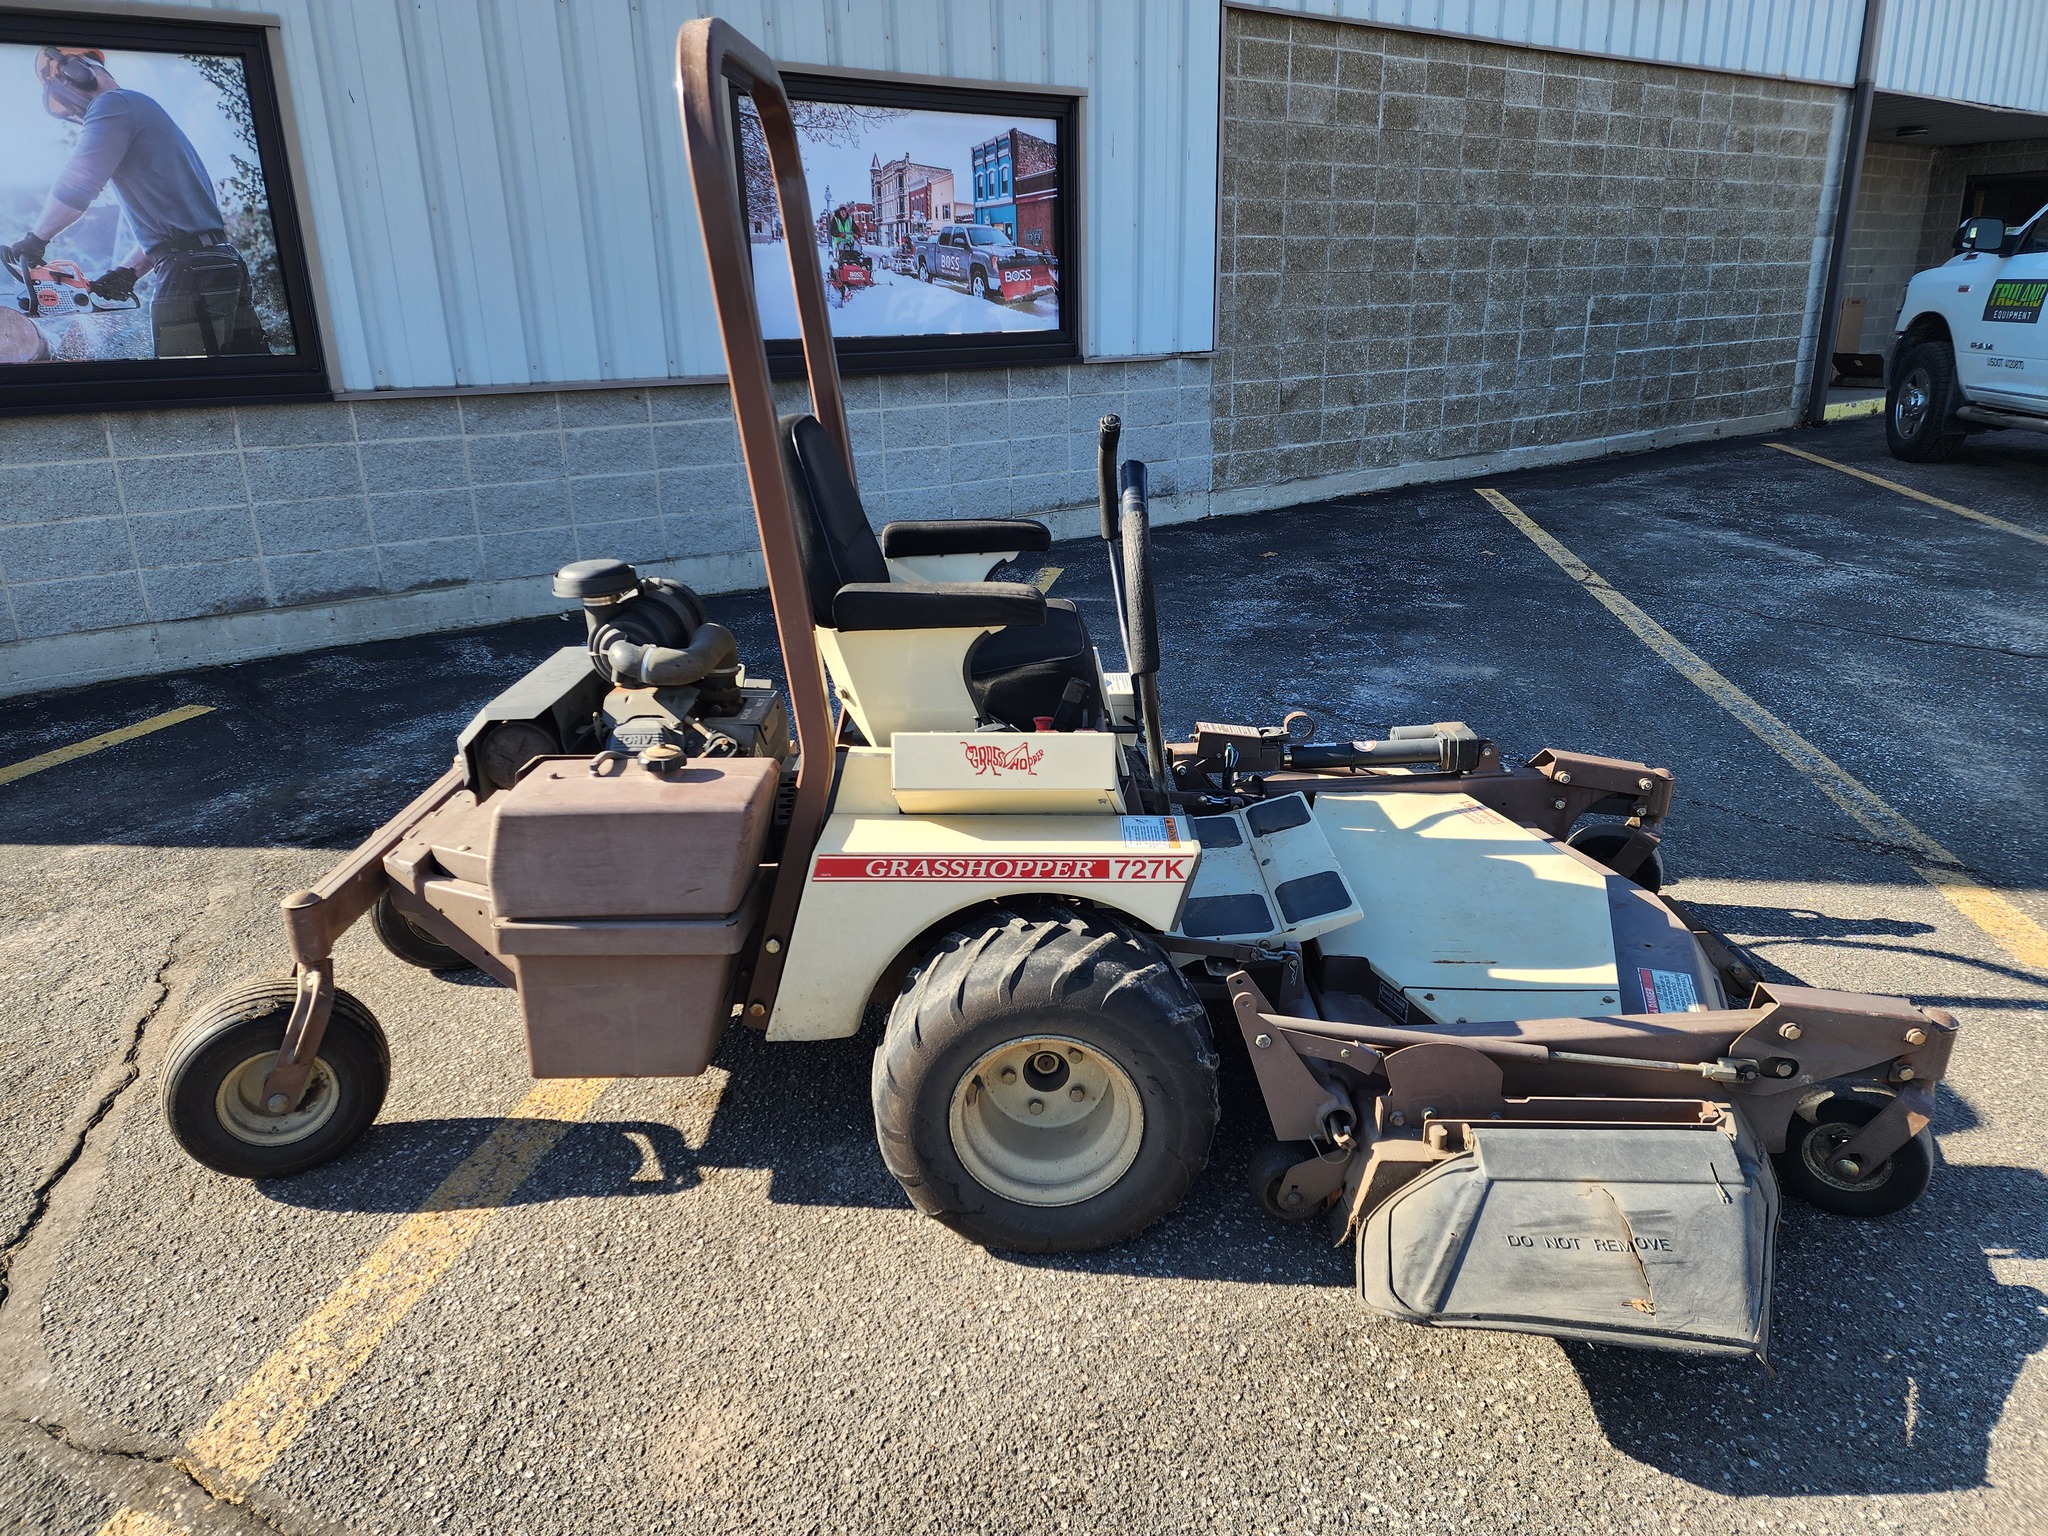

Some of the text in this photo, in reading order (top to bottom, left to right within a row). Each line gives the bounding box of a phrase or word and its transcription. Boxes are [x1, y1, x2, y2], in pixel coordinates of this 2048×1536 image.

[941, 254, 960, 271] BOSS
[1004, 268, 1032, 283] BOSS
[1989, 283, 2048, 307] TRULAND
[1993, 310, 2032, 320] EQUIPMENT
[621, 733, 653, 746] OHV
[961, 742, 1044, 776] GRASSHOPPER
[865, 859, 1185, 879] GRASSHOPPER 727K
[1505, 1234, 1674, 1253] DO NOT REMOVE
